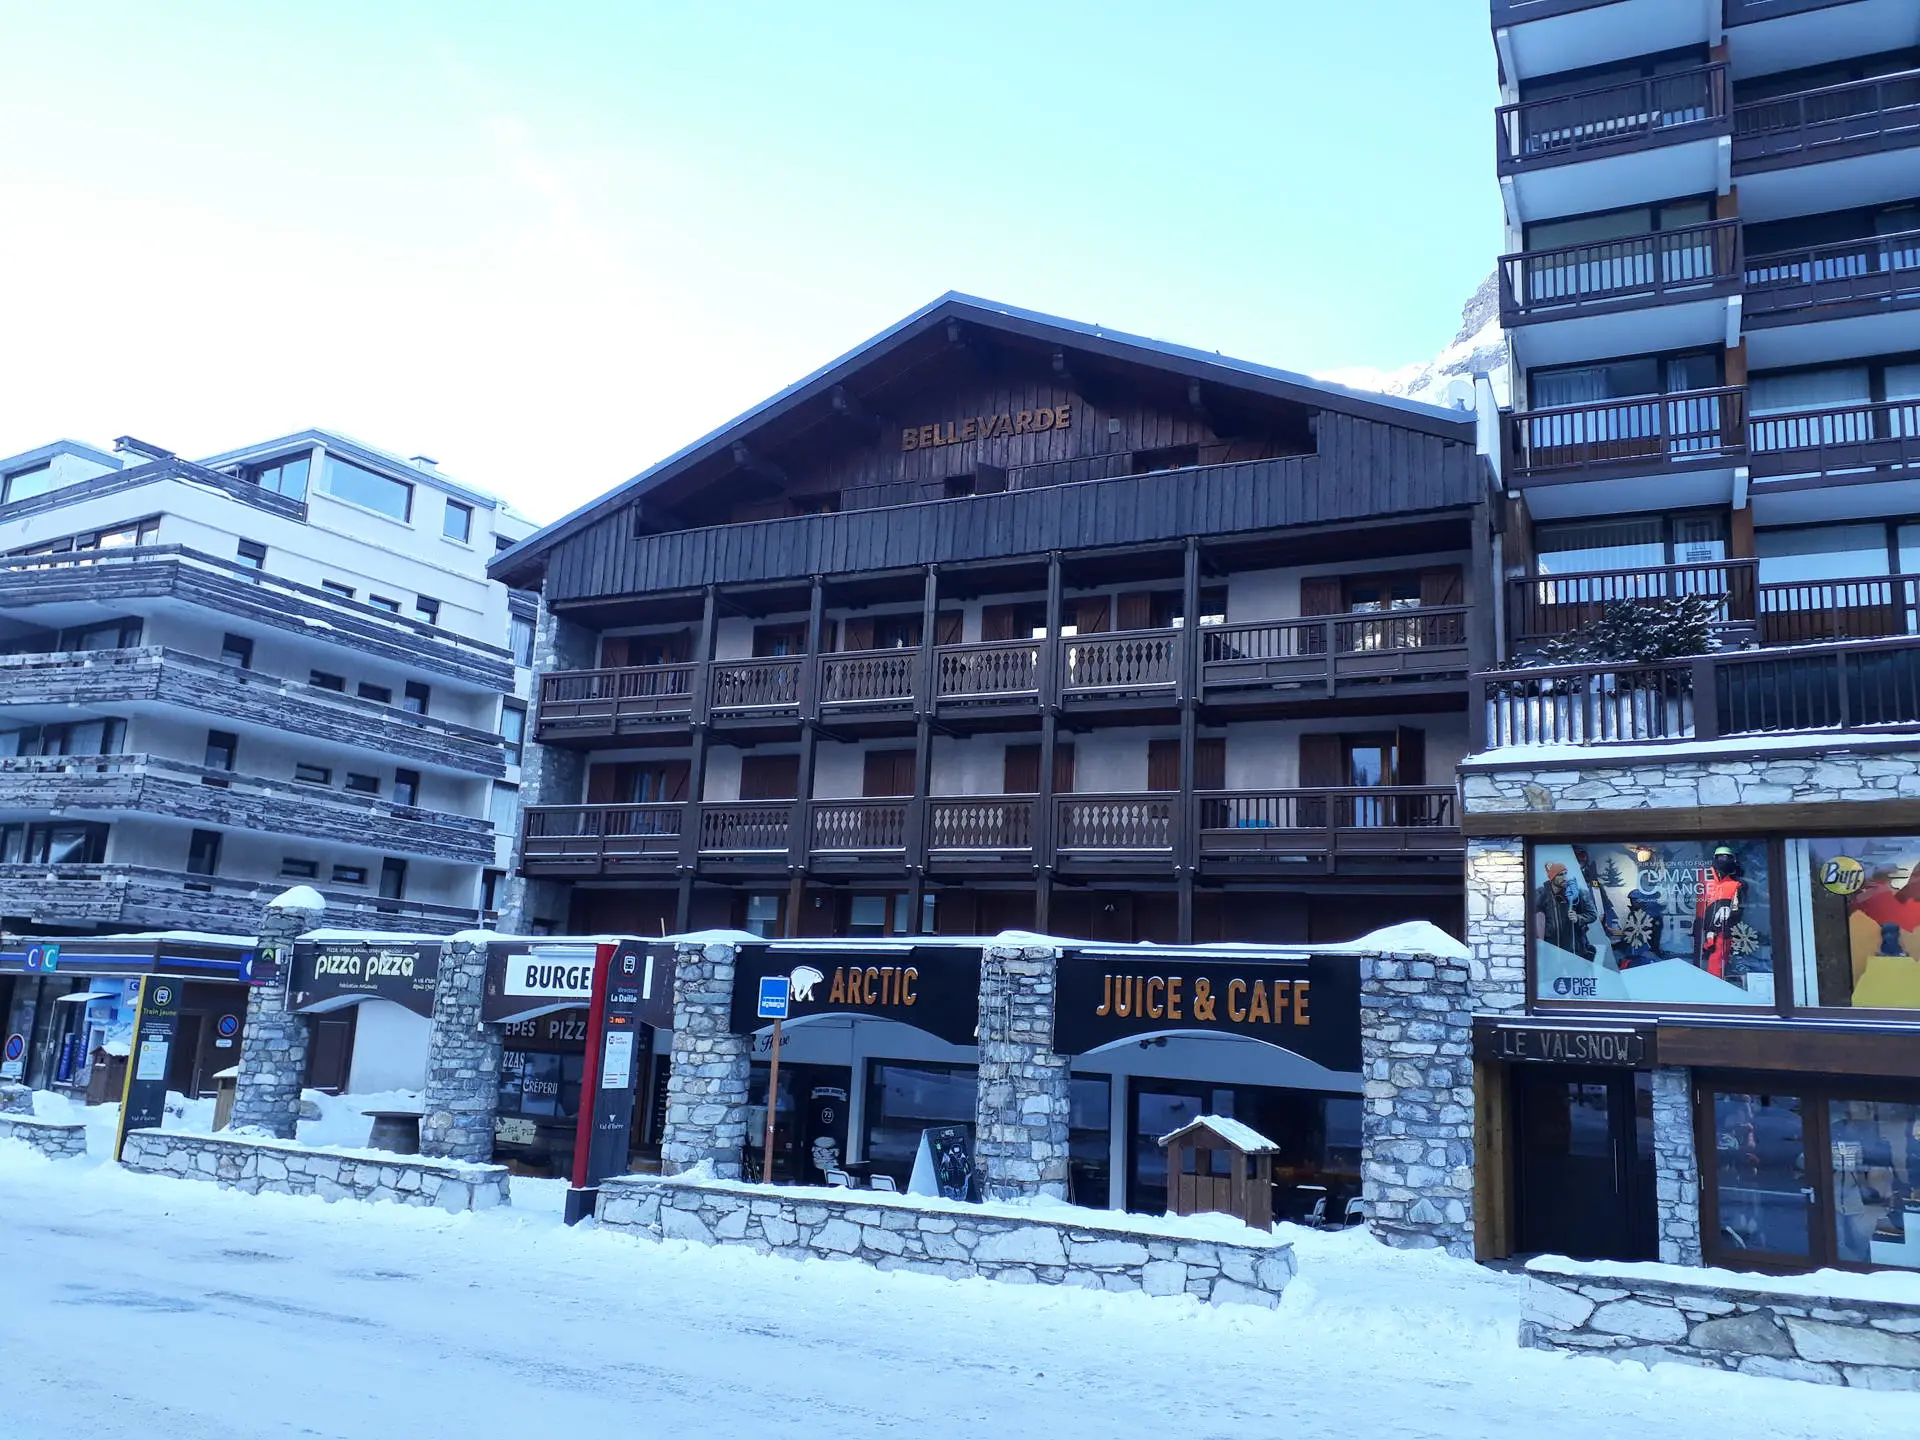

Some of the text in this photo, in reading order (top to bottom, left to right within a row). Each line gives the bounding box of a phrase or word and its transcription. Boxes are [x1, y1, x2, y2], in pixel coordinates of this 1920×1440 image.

[902, 405, 1071, 451] BELLEVARDE
[28, 948, 56, 968] CIC
[314, 955, 414, 982] pizza pizza
[525, 965, 594, 990] BURGE
[829, 966, 918, 1006] ARCTIC
[1572, 977, 1598, 987] PICT
[610, 993, 618, 1002] La
[1096, 974, 1311, 1026] JUICE & CAFE
[1572, 986, 1597, 996] URE
[505, 1021, 587, 1040] EPES PIZZ
[1503, 1031, 1630, 1061] LE VALSNOW
[503, 1051, 525, 1069] ZZAS
